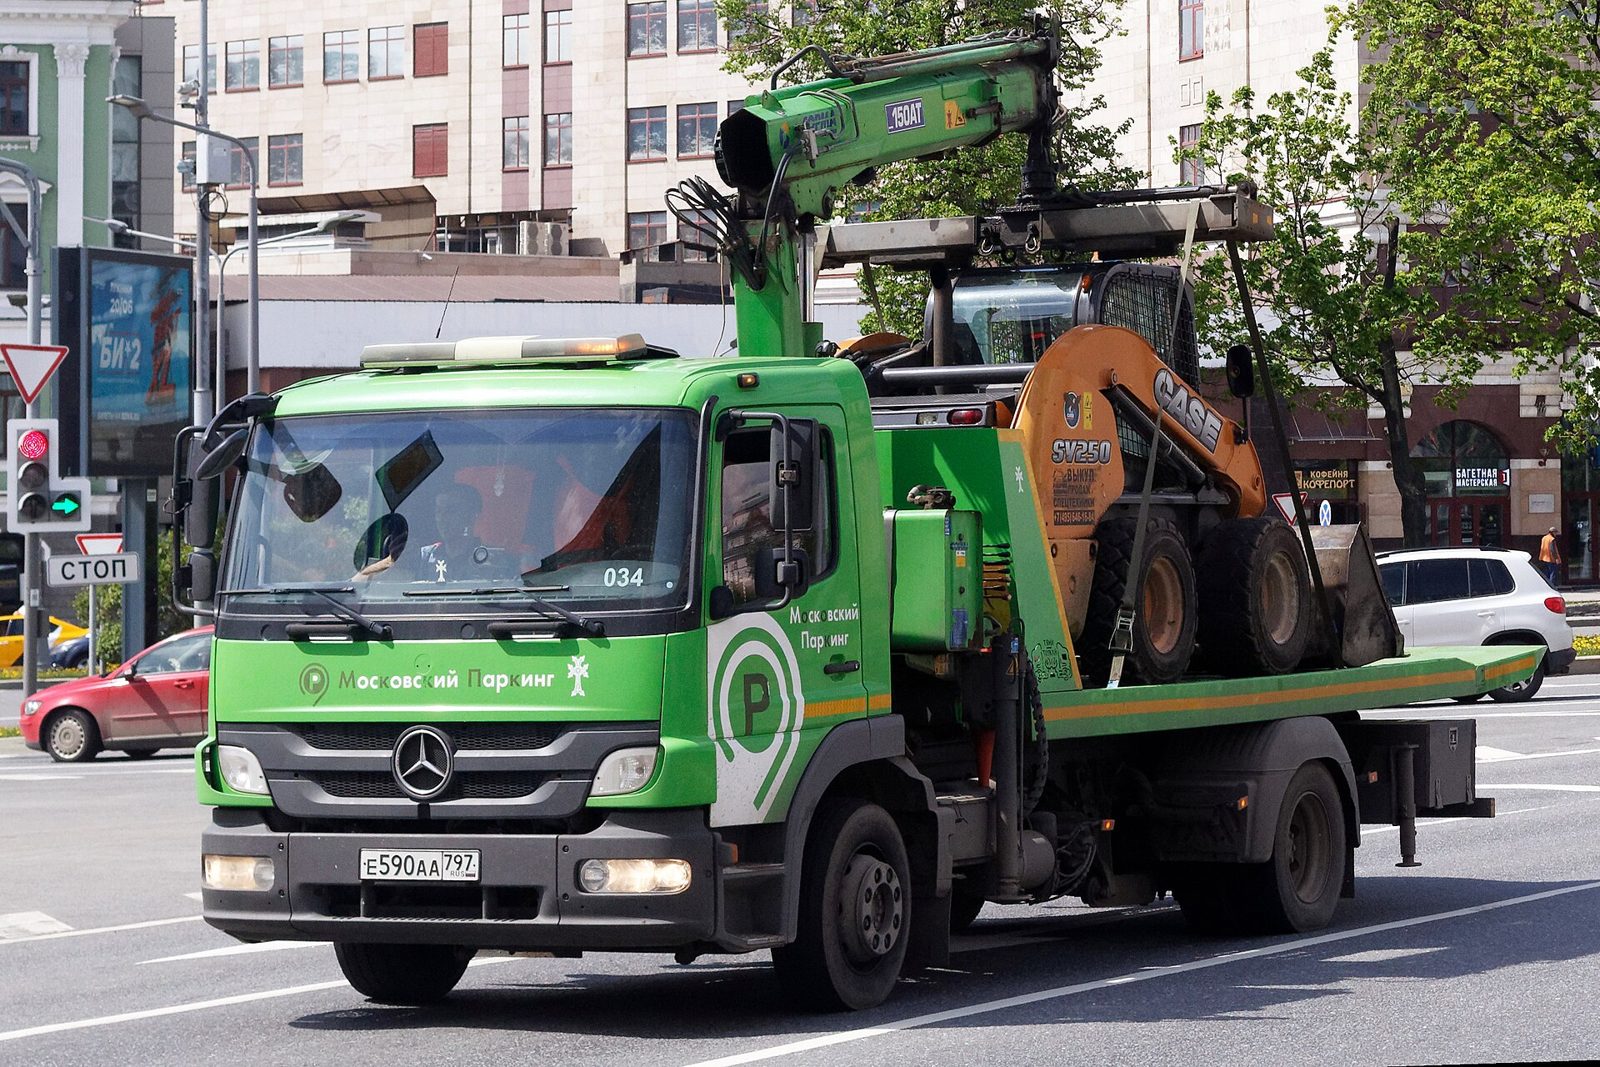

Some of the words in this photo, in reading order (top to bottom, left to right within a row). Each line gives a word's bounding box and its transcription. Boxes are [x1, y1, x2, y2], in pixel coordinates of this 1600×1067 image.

[1153, 369, 1223, 453] CASE
[1052, 439, 1111, 464] SV250
[1310, 468, 1349, 478] КОФЕЙНЯ
[1456, 468, 1498, 479] БАГЕТНАЯ
[1456, 479, 1498, 487] МАСТЕРСКАЯ
[1303, 479, 1355, 489] КОФЕПОРТ
[61, 559, 126, 580] СТОП
[603, 567, 644, 588] 034
[790, 603, 859, 624] Московский
[801, 631, 849, 653] Паркинг
[338, 669, 459, 690] Московский
[467, 668, 555, 693] Паркинг
[444, 854, 473, 871] 797
[450, 870, 465, 878] RUS
